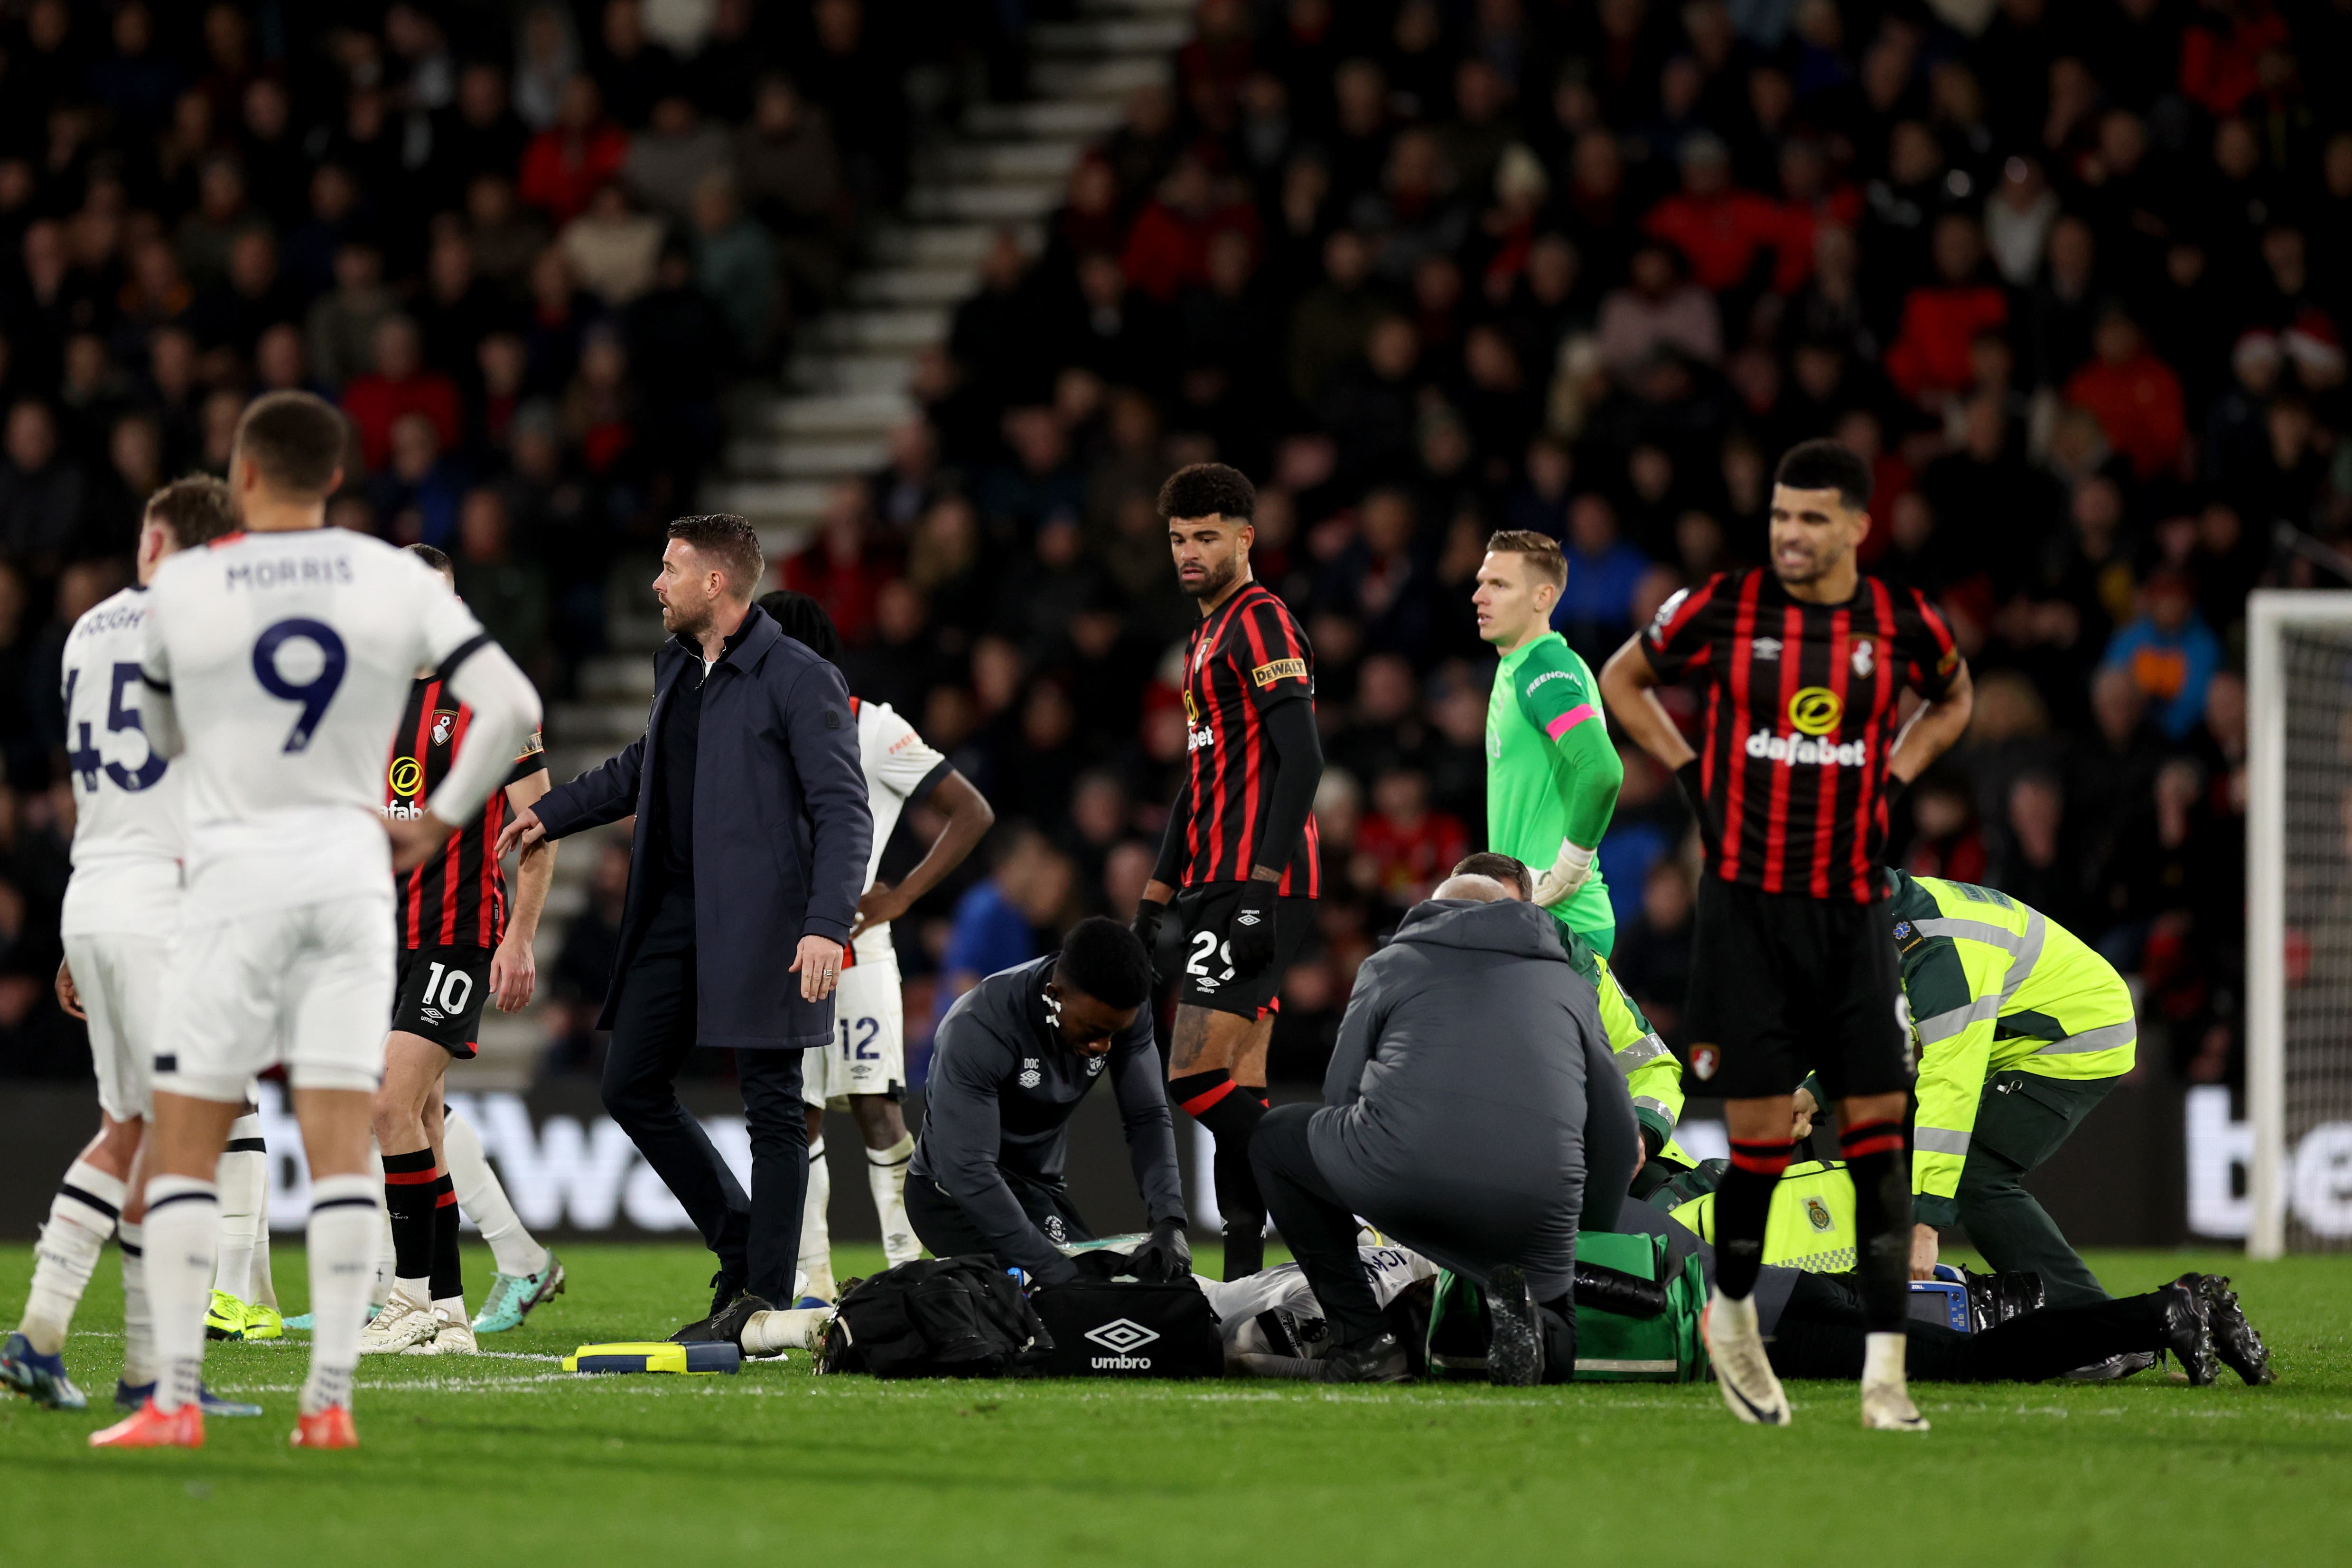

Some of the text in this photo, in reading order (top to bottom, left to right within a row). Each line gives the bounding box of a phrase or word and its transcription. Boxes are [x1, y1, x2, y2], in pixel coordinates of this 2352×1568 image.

[226, 556, 354, 591] MORRIS
[252, 617, 348, 754] 9
[65, 663, 169, 793] 45
[1745, 728, 1866, 767] dafabet
[421, 961, 473, 1015] 10
[1196, 986, 1215, 994] umbro
[420, 1015, 439, 1026] umbro
[840, 1017, 879, 1061] 12
[1024, 1058, 1040, 1069] DOC
[1092, 1354, 1151, 1369] umbro
